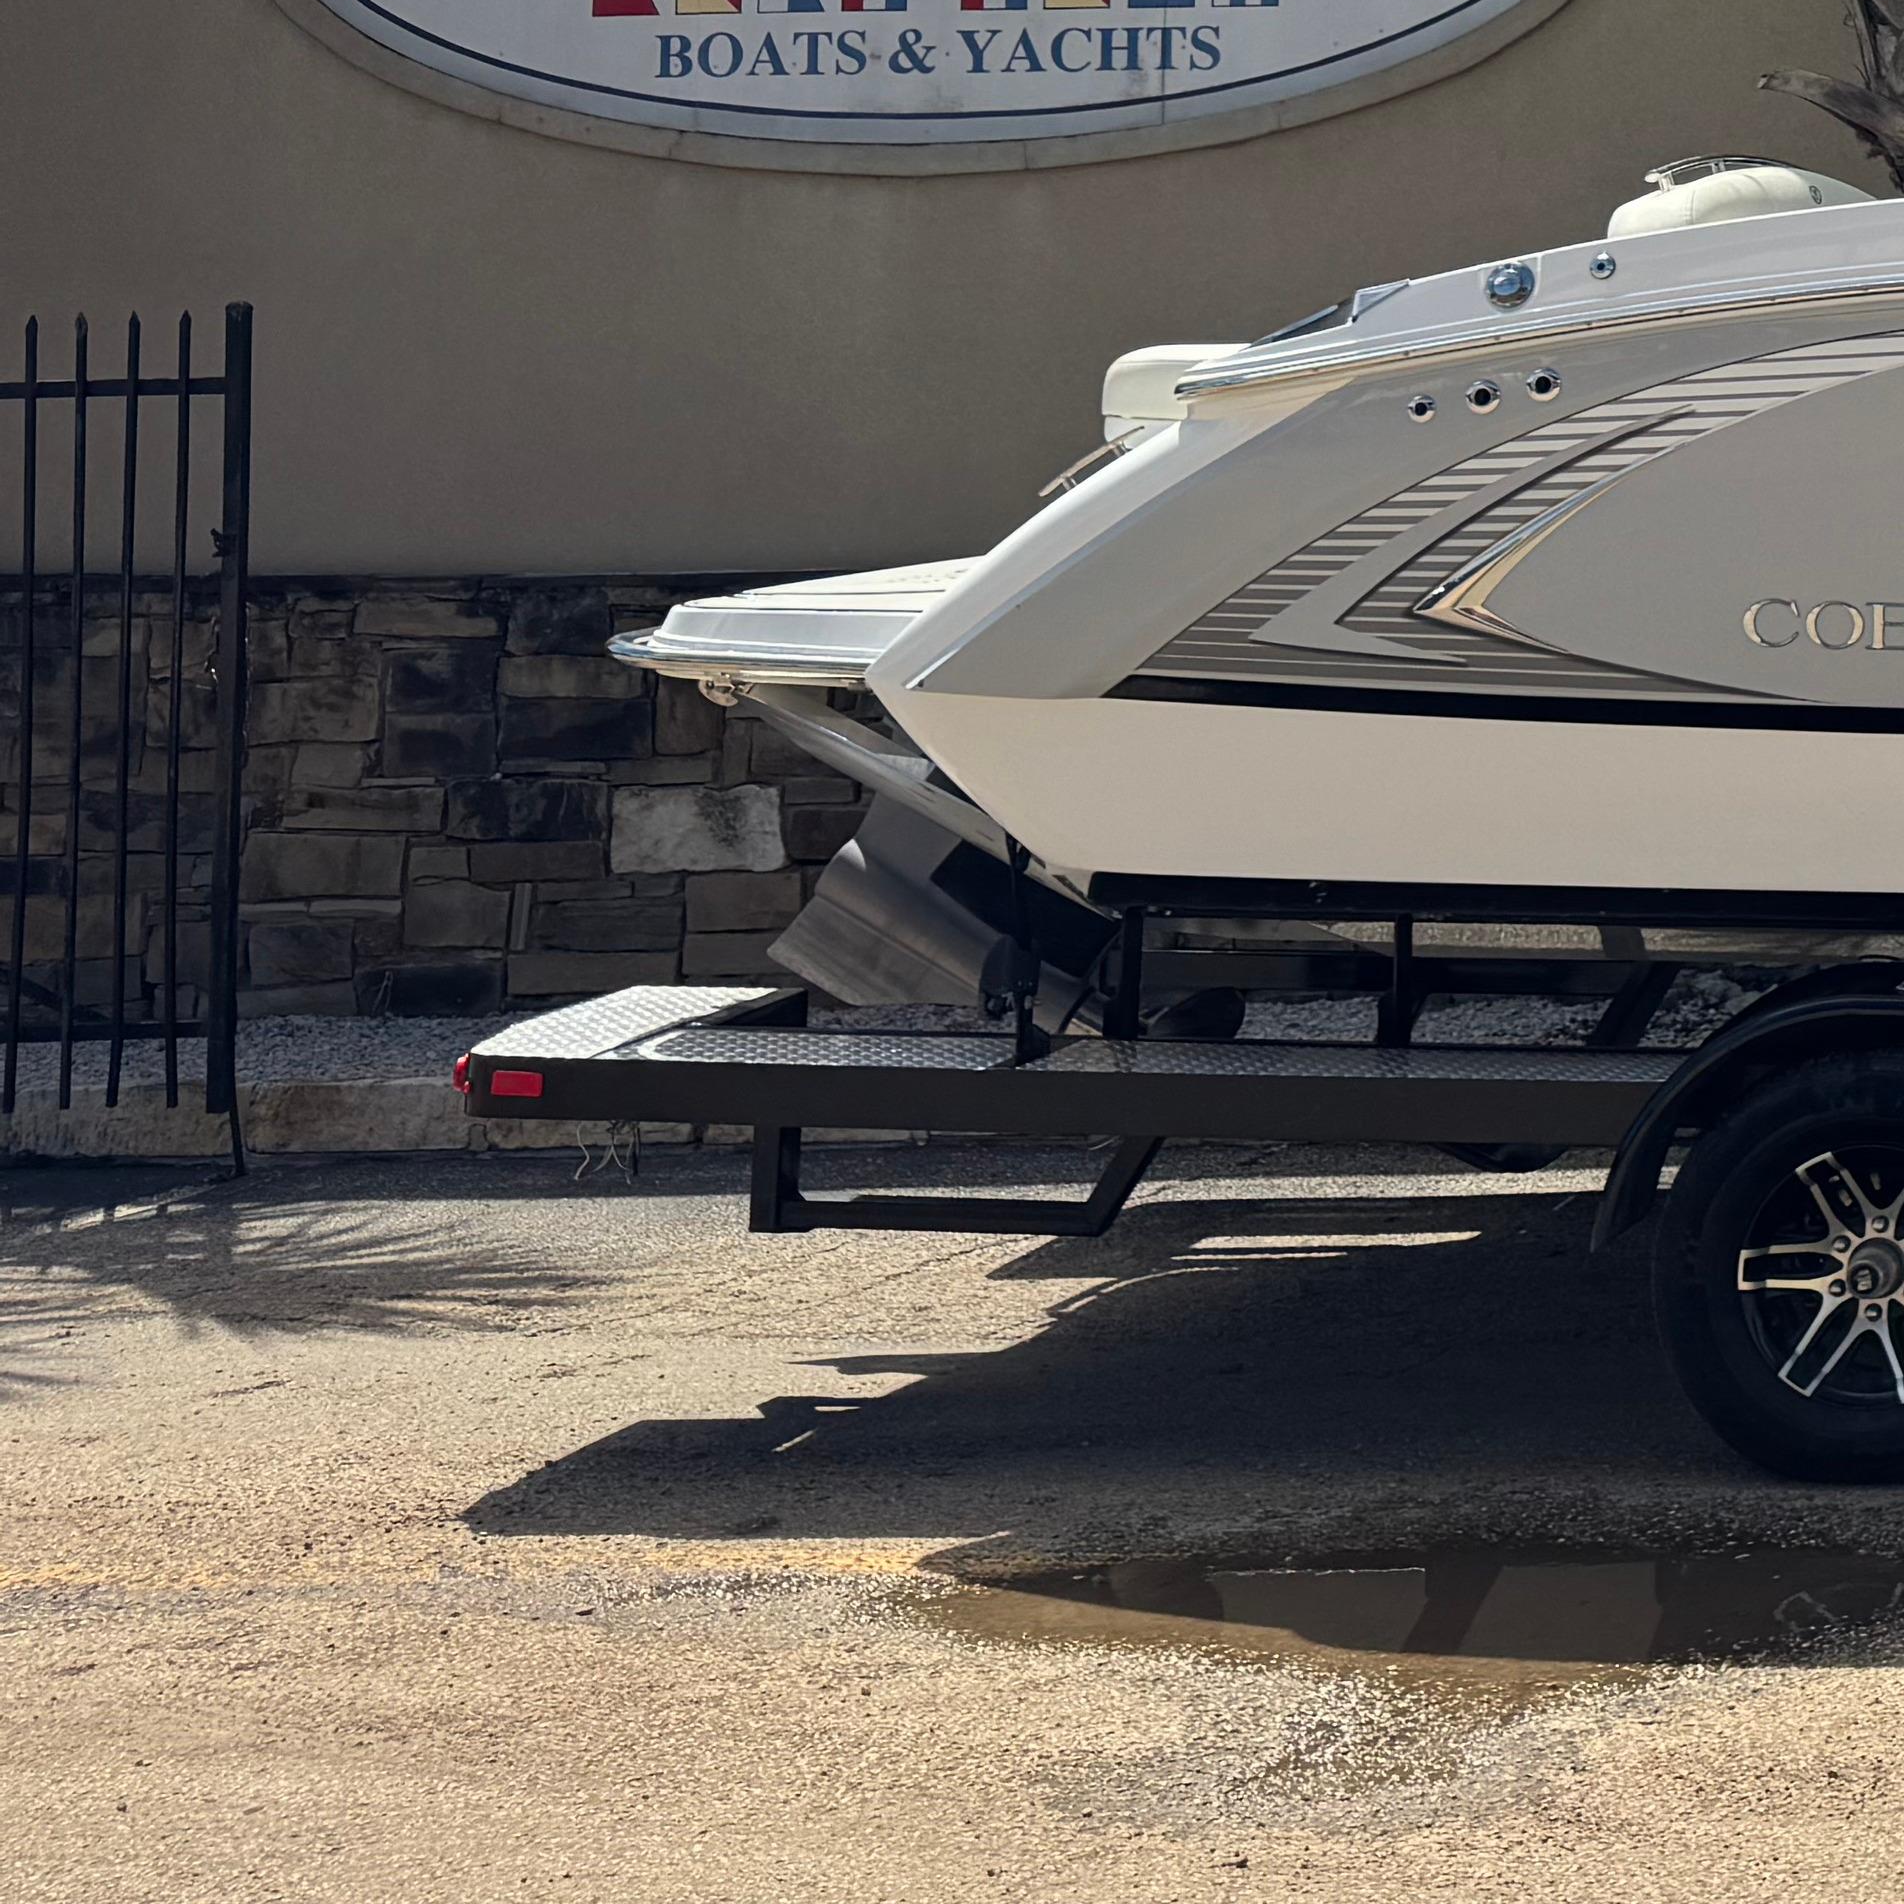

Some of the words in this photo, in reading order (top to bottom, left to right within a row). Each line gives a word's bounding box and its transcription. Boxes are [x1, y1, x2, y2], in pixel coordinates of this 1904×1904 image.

[655, 29, 867, 79] BOATS
[888, 29, 937, 75] &
[955, 25, 1221, 75] YACHTS
